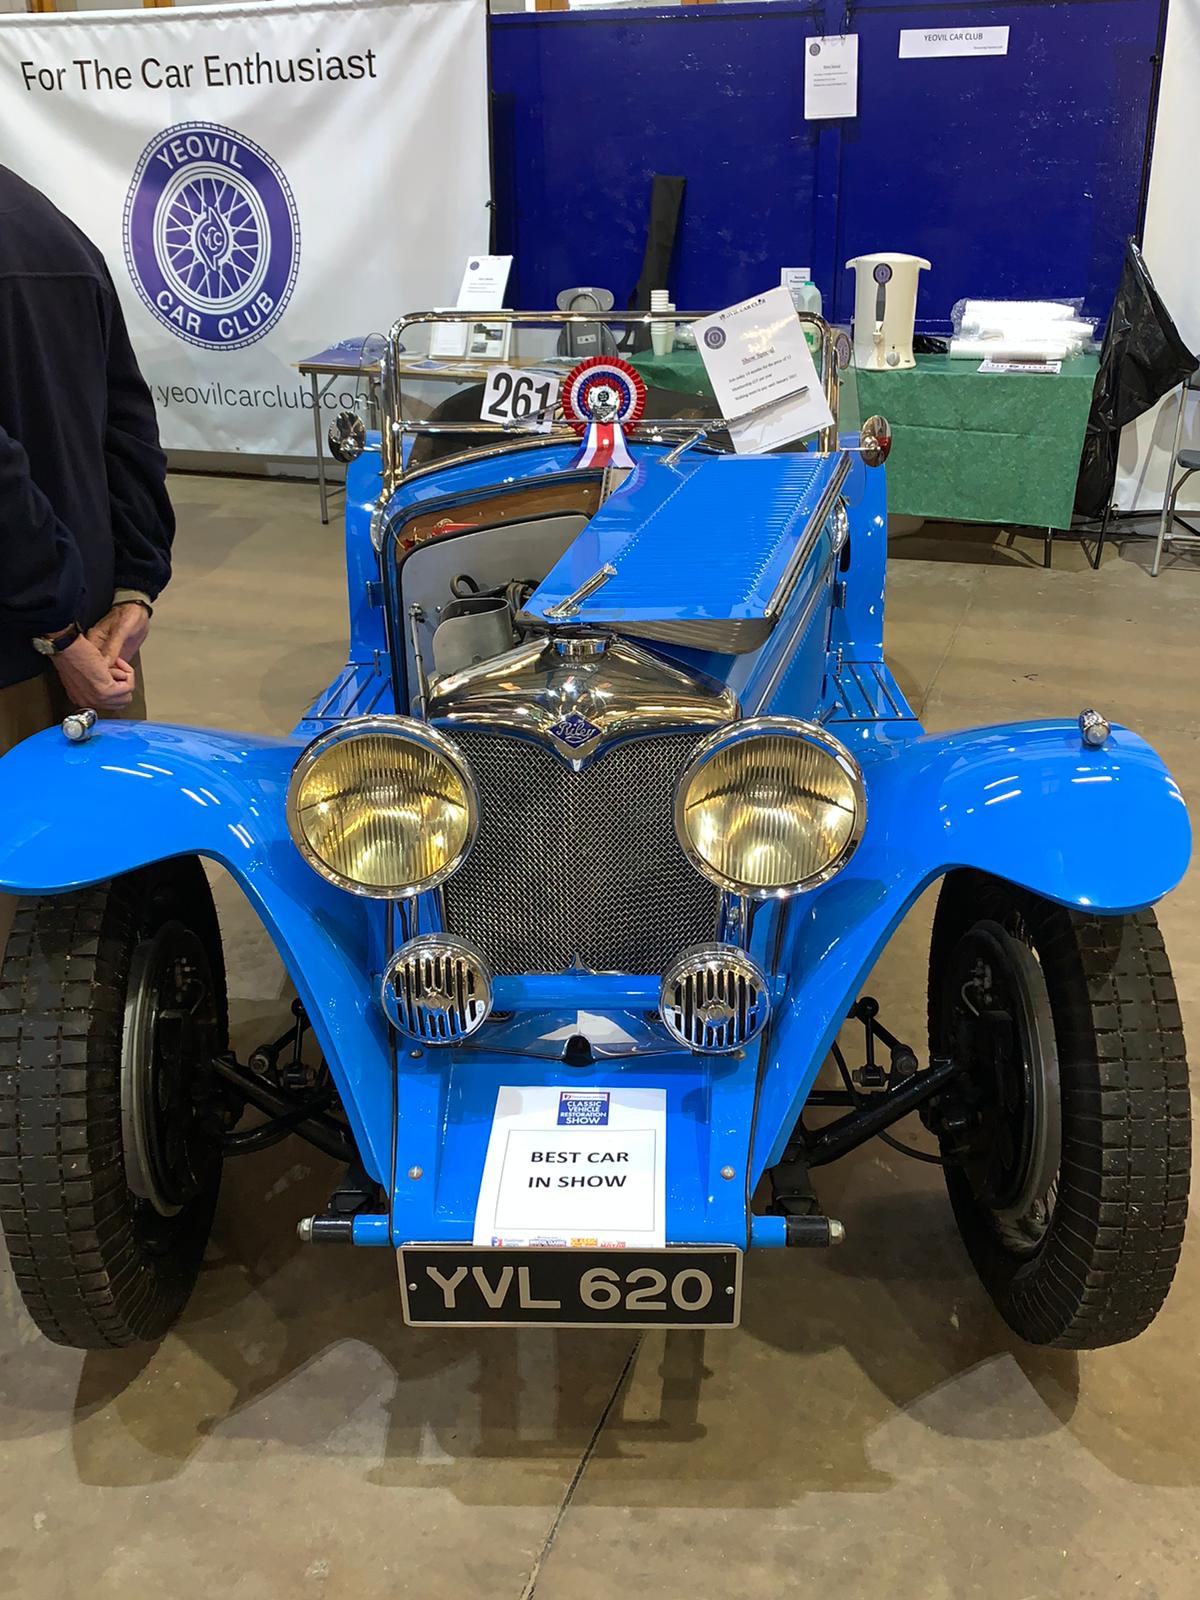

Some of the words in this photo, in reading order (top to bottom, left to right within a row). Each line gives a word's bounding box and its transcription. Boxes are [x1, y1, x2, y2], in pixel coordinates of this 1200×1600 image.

[923, 34, 949, 42] YEOVIL
[949, 33, 964, 41] CAR
[964, 33, 983, 41] CLUB
[20, 60, 66, 91] For
[73, 58, 132, 90] The
[140, 57, 194, 88] Car
[204, 47, 377, 87] Enthusiast
[157, 135, 243, 170] YEOVIL
[156, 289, 202, 334] CAR
[217, 290, 274, 340] CLUB
[150, 381, 380, 410] .yeovilcarclub.com
[488, 372, 551, 426] 261
[556, 721, 597, 744] Riley
[531, 1152, 581, 1163] BEST
[587, 1152, 629, 1163] CAR
[528, 1176, 551, 1188] IN
[557, 1175, 627, 1188] SHOW
[426, 1266, 561, 1308] YVL
[579, 1268, 713, 1311] 620
